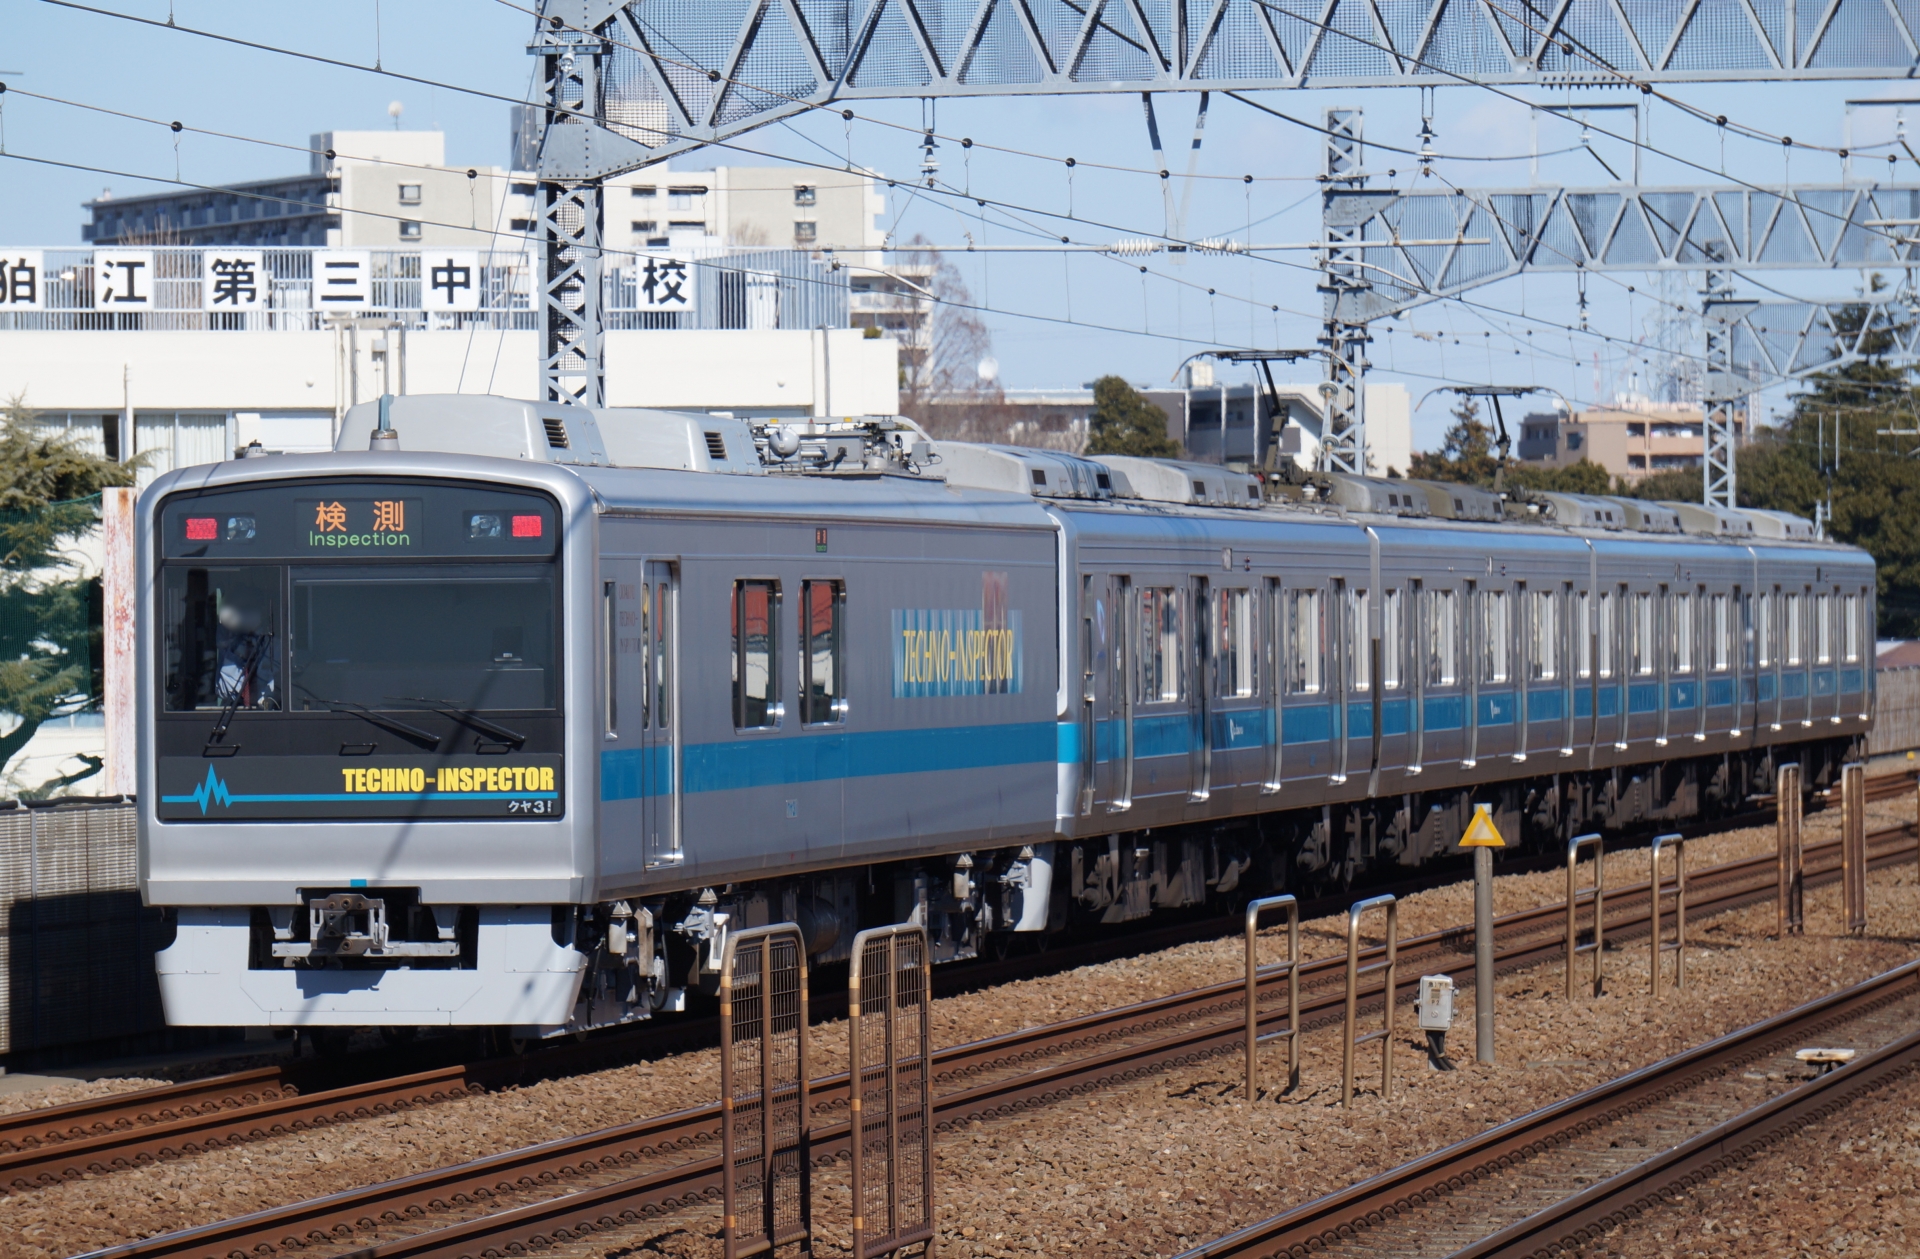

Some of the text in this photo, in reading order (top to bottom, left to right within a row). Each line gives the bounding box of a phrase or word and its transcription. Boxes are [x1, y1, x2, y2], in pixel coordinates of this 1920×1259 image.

[0, 257, 688, 306] 狛江第三中校
[309, 531, 410, 547] Inspection
[903, 629, 1013, 683] TECHNO-INSPECTOR
[342, 767, 554, 792] TECHNO-INSPECTOR
